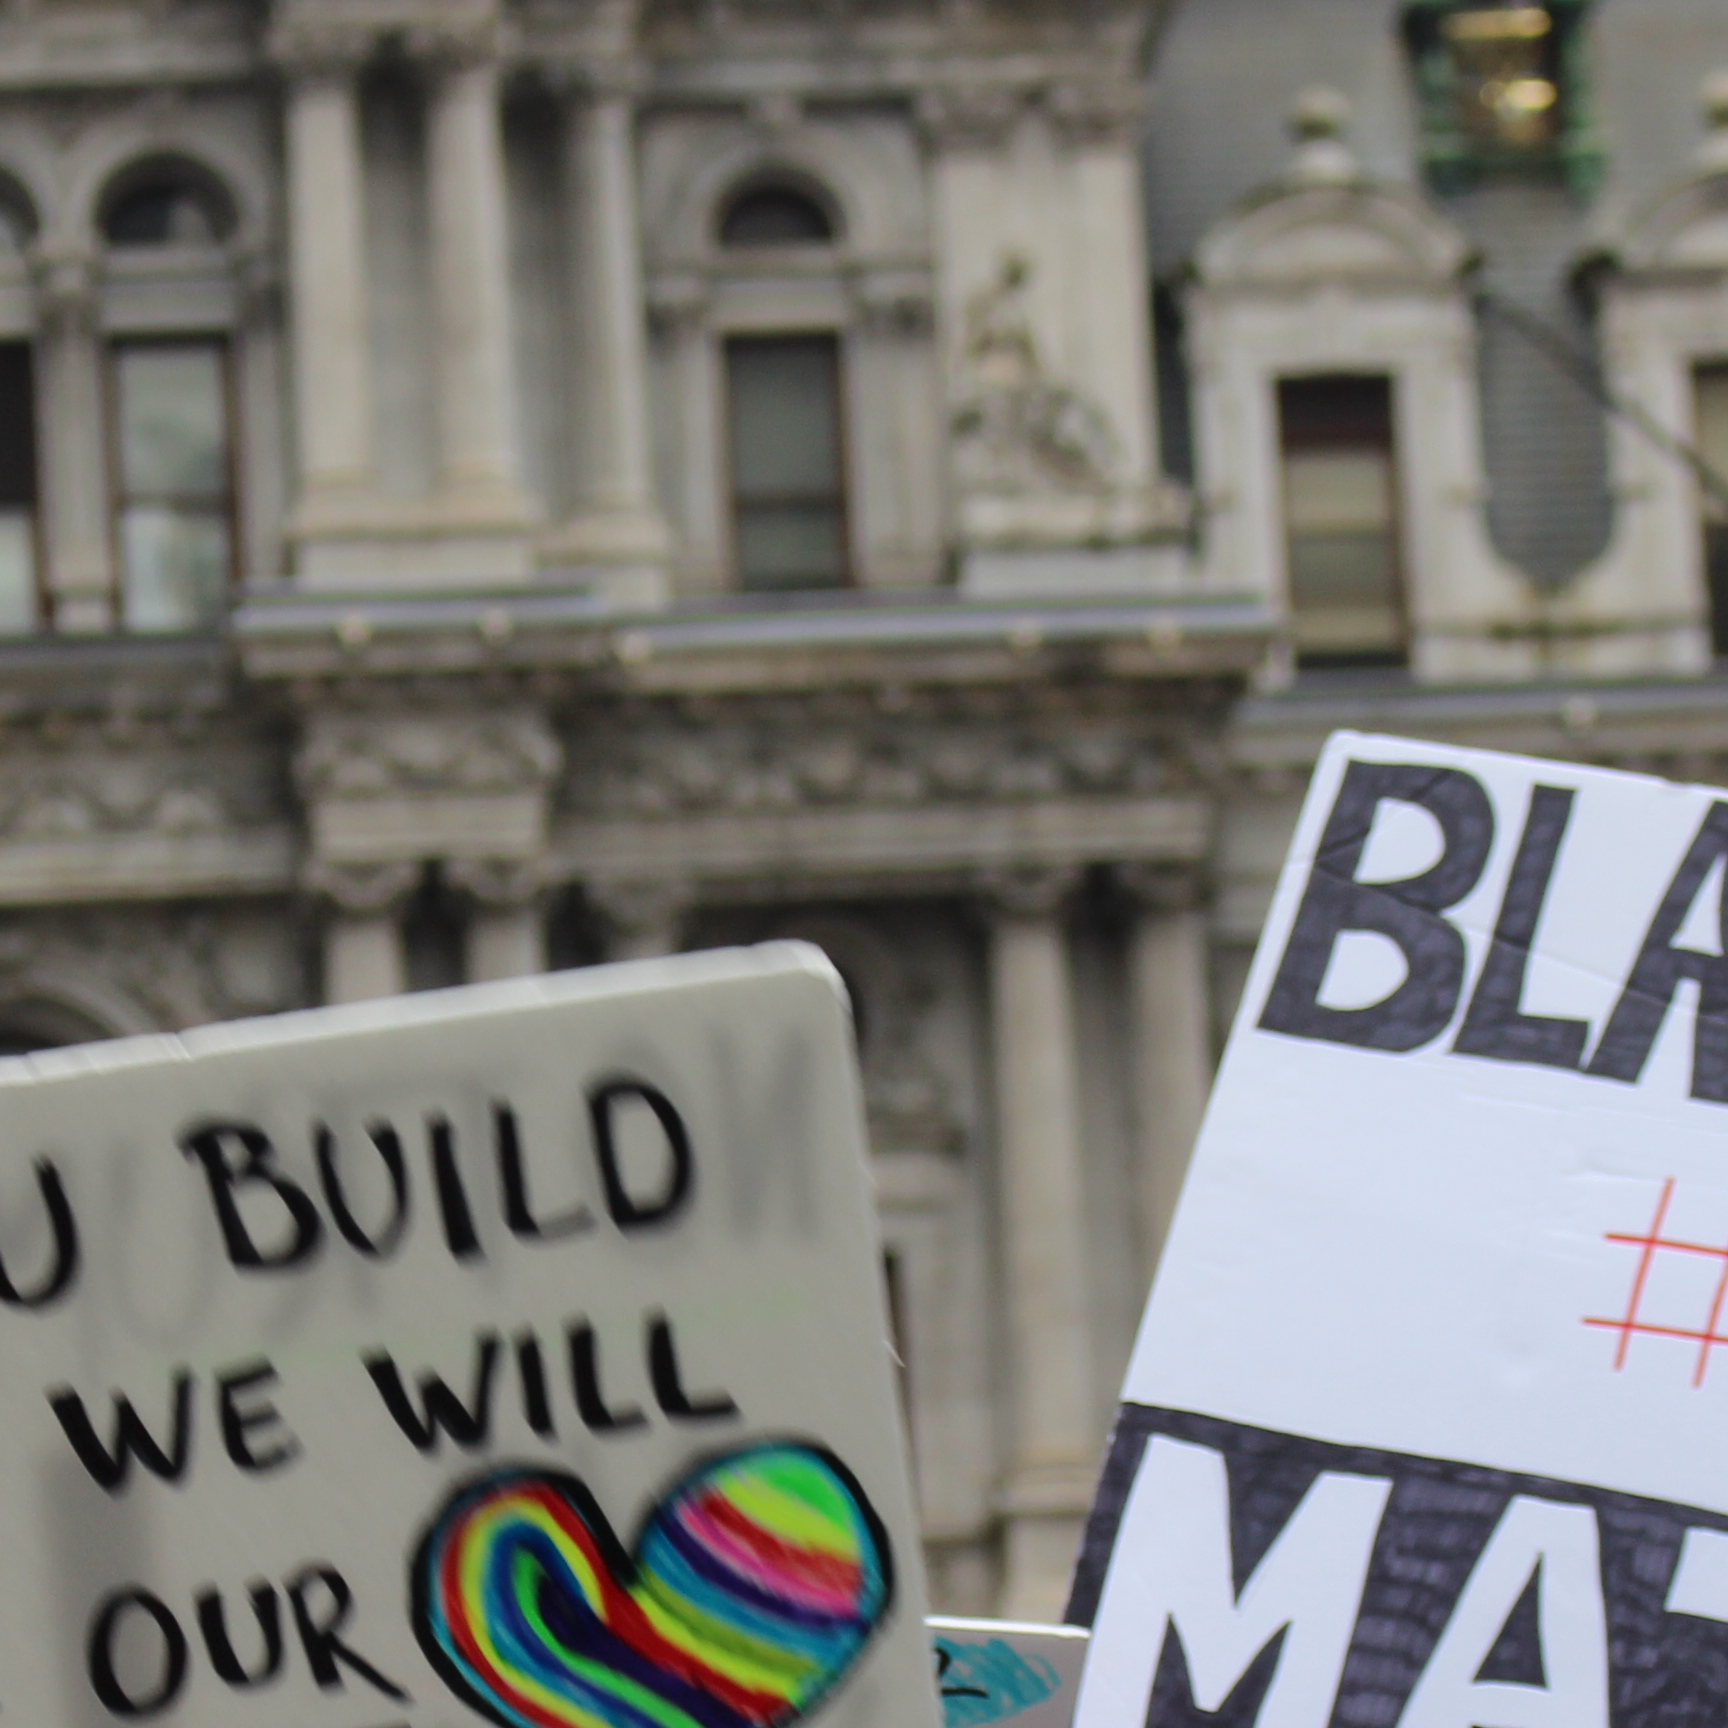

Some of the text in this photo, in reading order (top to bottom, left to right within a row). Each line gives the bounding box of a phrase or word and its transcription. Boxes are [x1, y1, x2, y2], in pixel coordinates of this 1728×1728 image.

[180, 1076, 694, 1270] BUILD
[49, 1363, 298, 1496] WE
[365, 1315, 738, 1453] WILL
[86, 1566, 405, 1720] OUR
